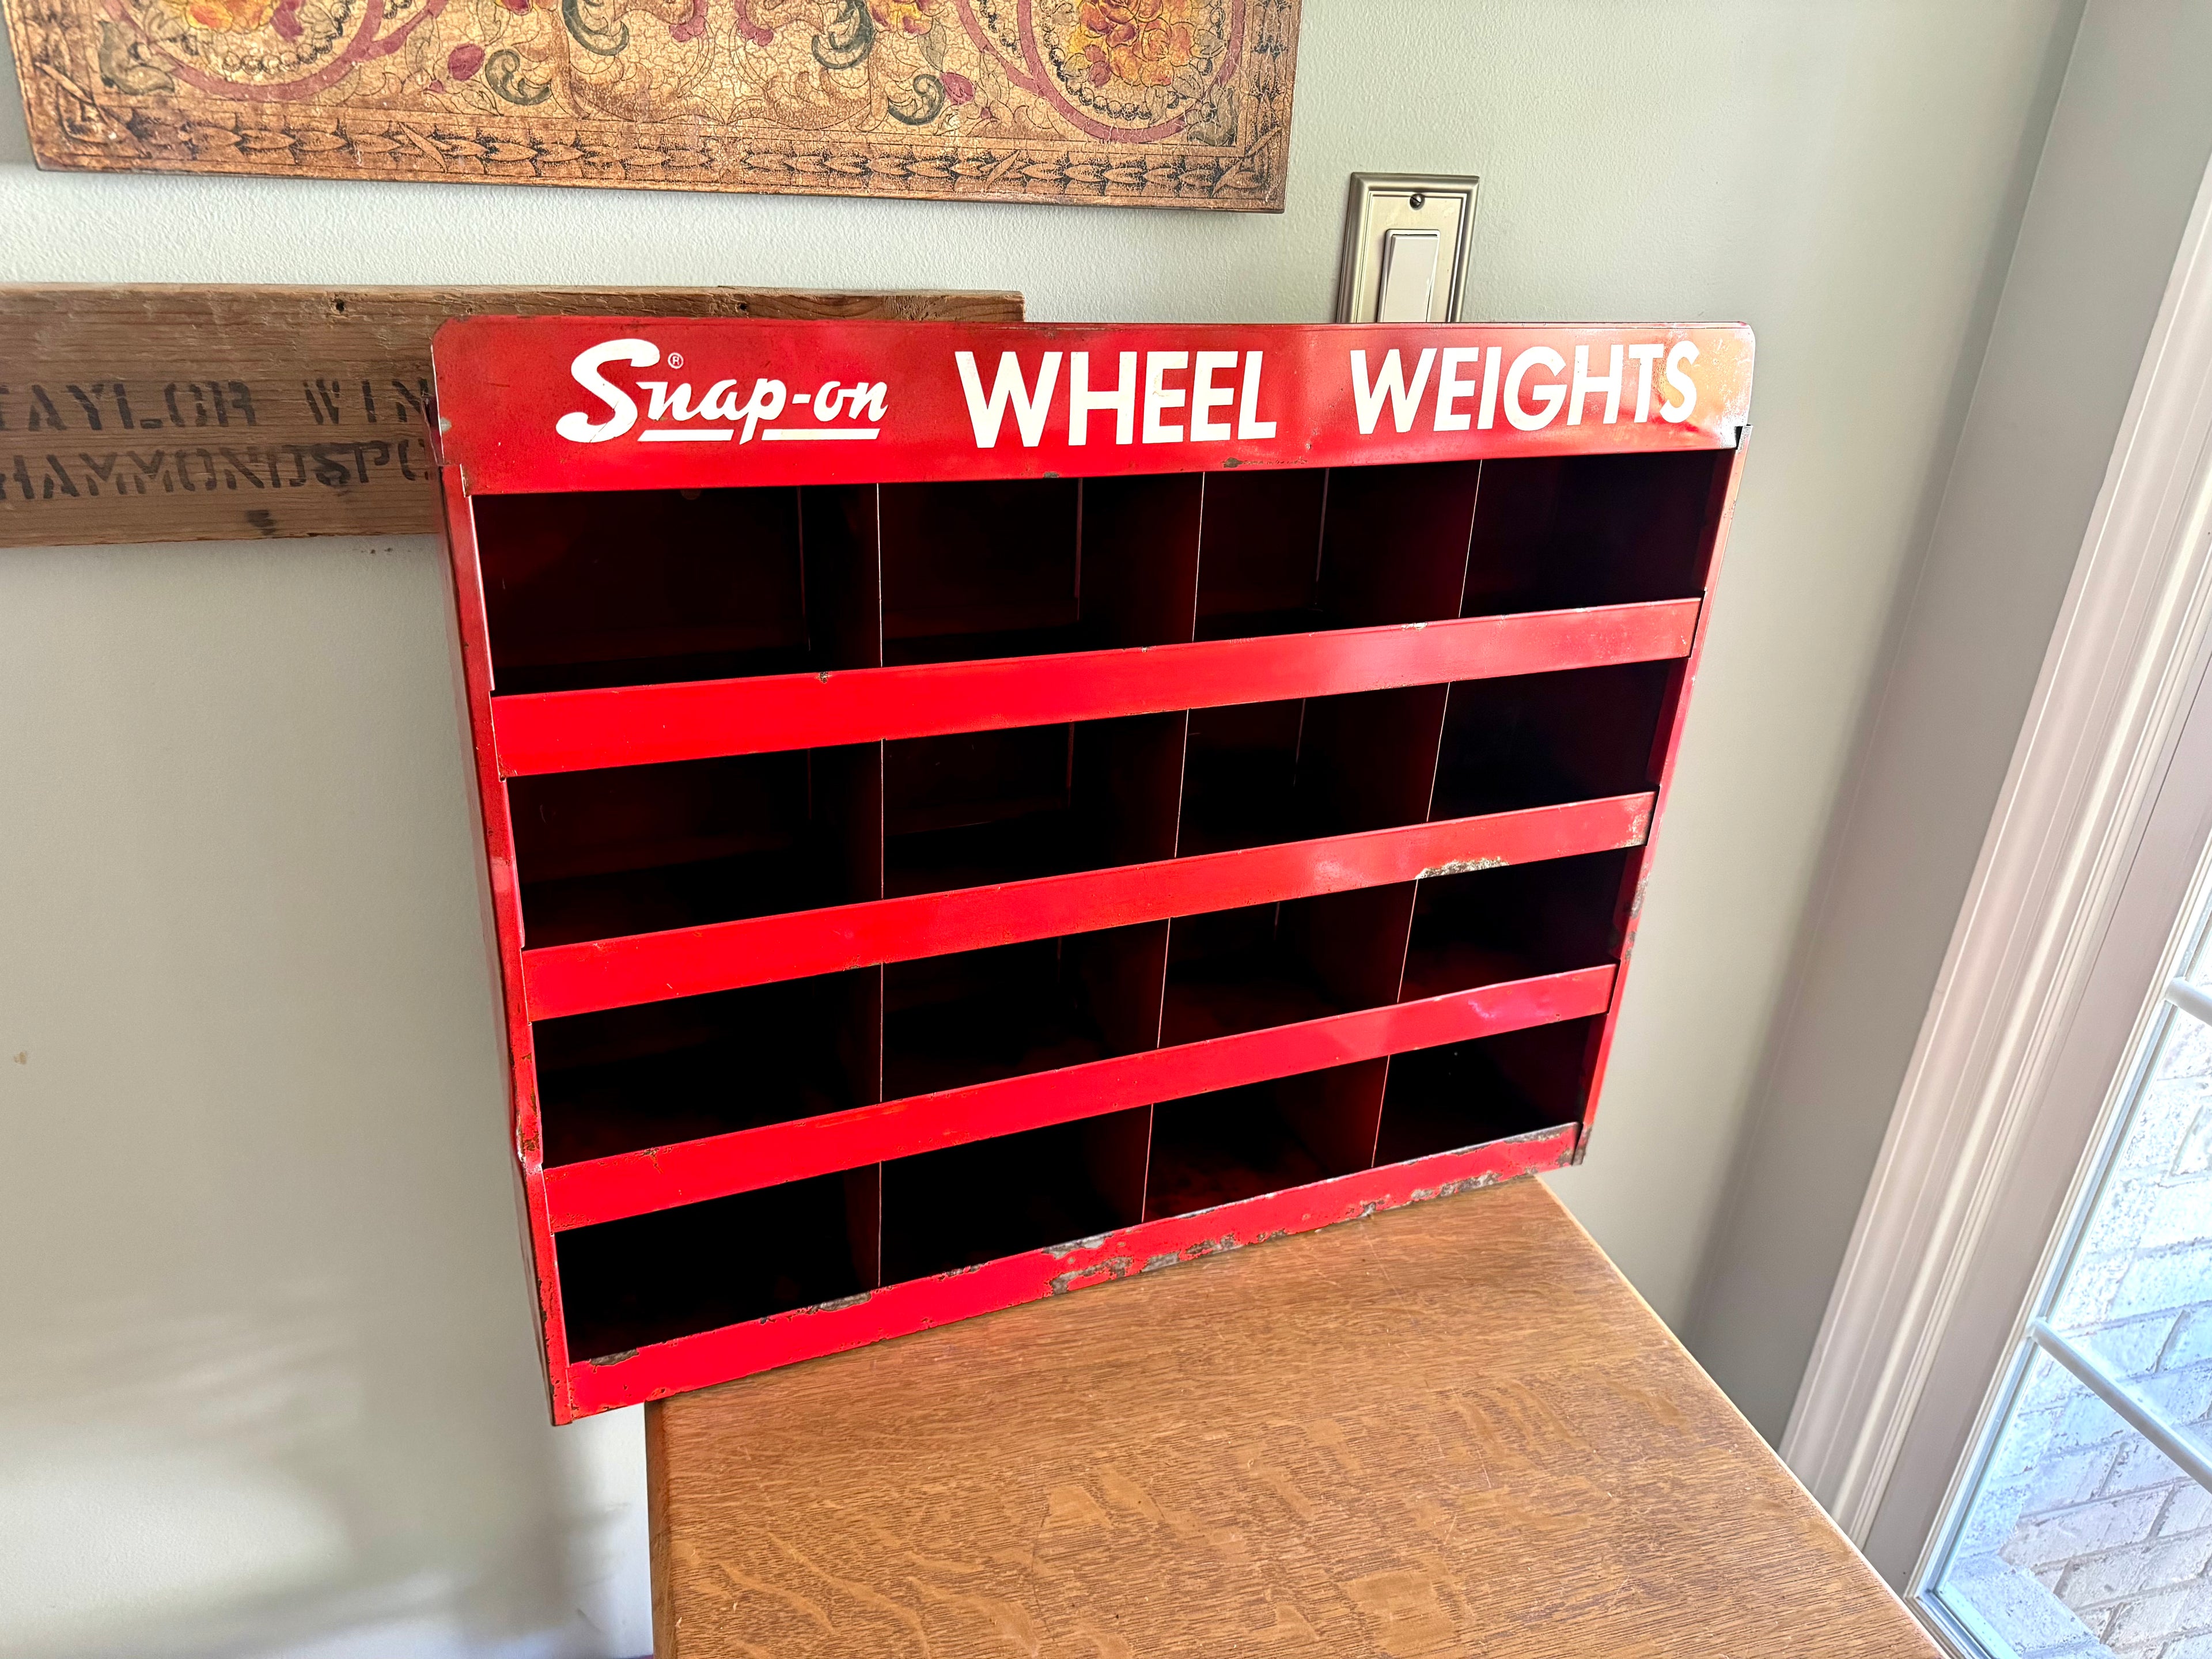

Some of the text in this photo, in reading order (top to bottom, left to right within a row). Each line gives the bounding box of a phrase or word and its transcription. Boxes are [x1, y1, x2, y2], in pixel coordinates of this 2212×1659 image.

[555, 338, 1700, 449] Snap-on WHEEL WEIGHTS
